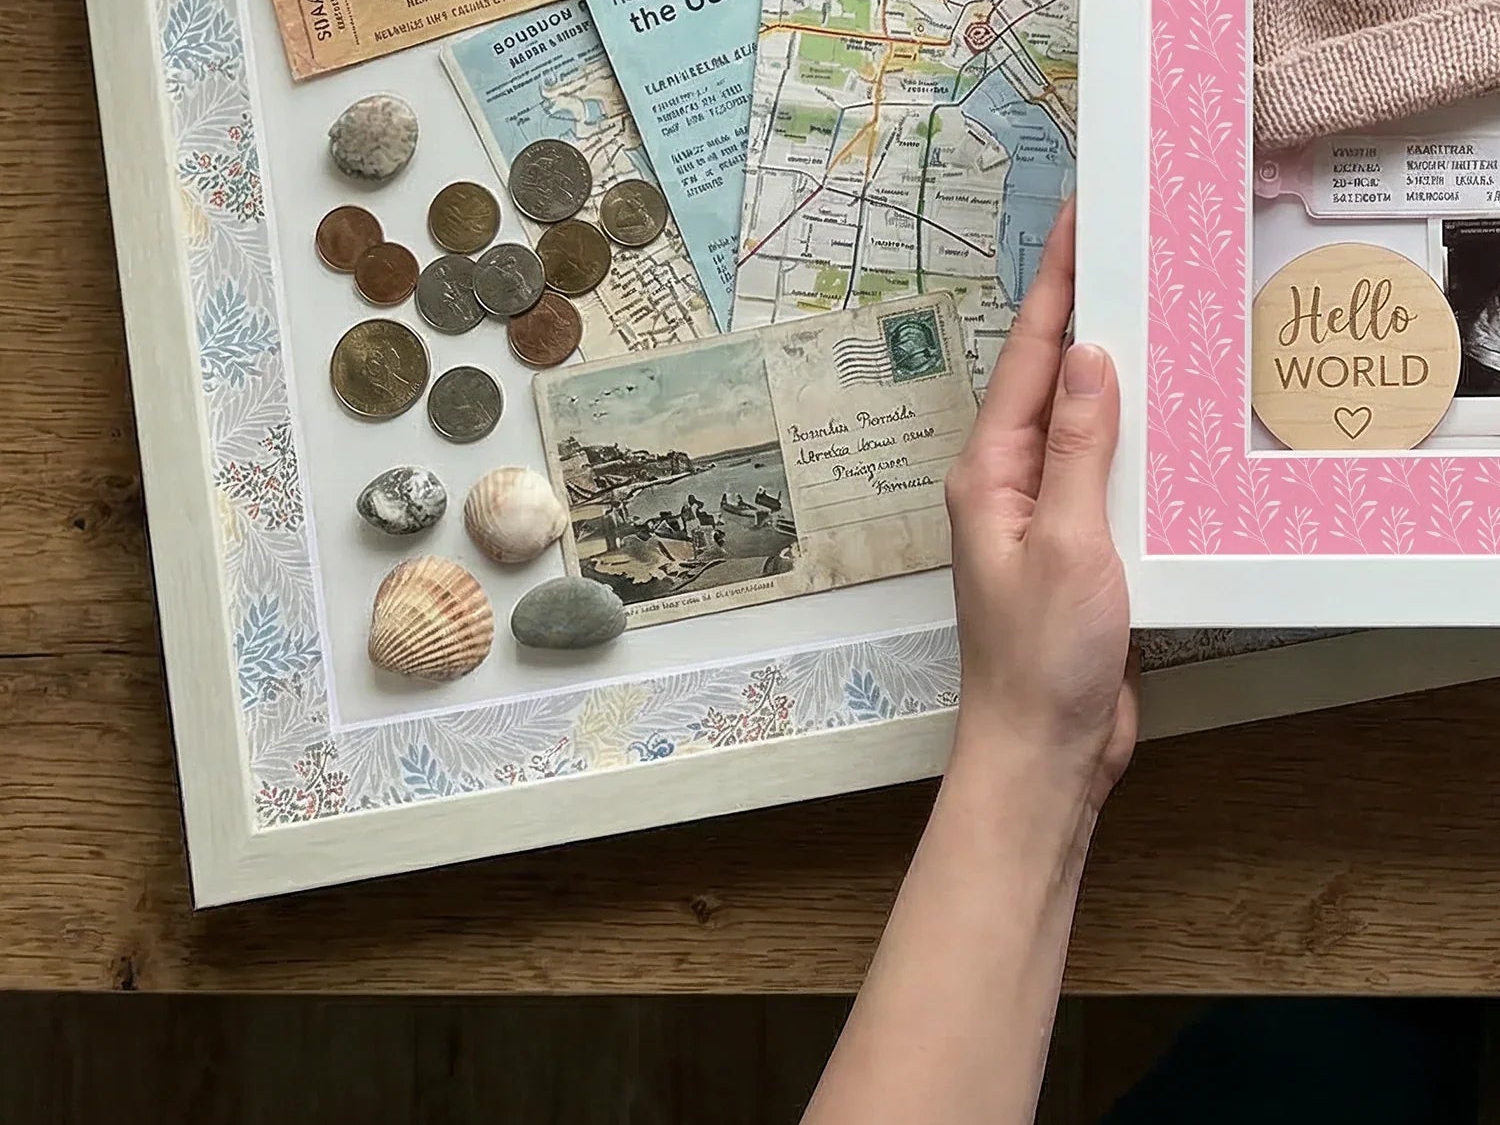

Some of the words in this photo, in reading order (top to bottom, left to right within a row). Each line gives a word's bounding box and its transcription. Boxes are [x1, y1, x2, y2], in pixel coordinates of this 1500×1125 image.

[629, 3, 677, 36] the
[1278, 278, 1419, 347] Hello
[1274, 355, 1429, 390] WORLD
